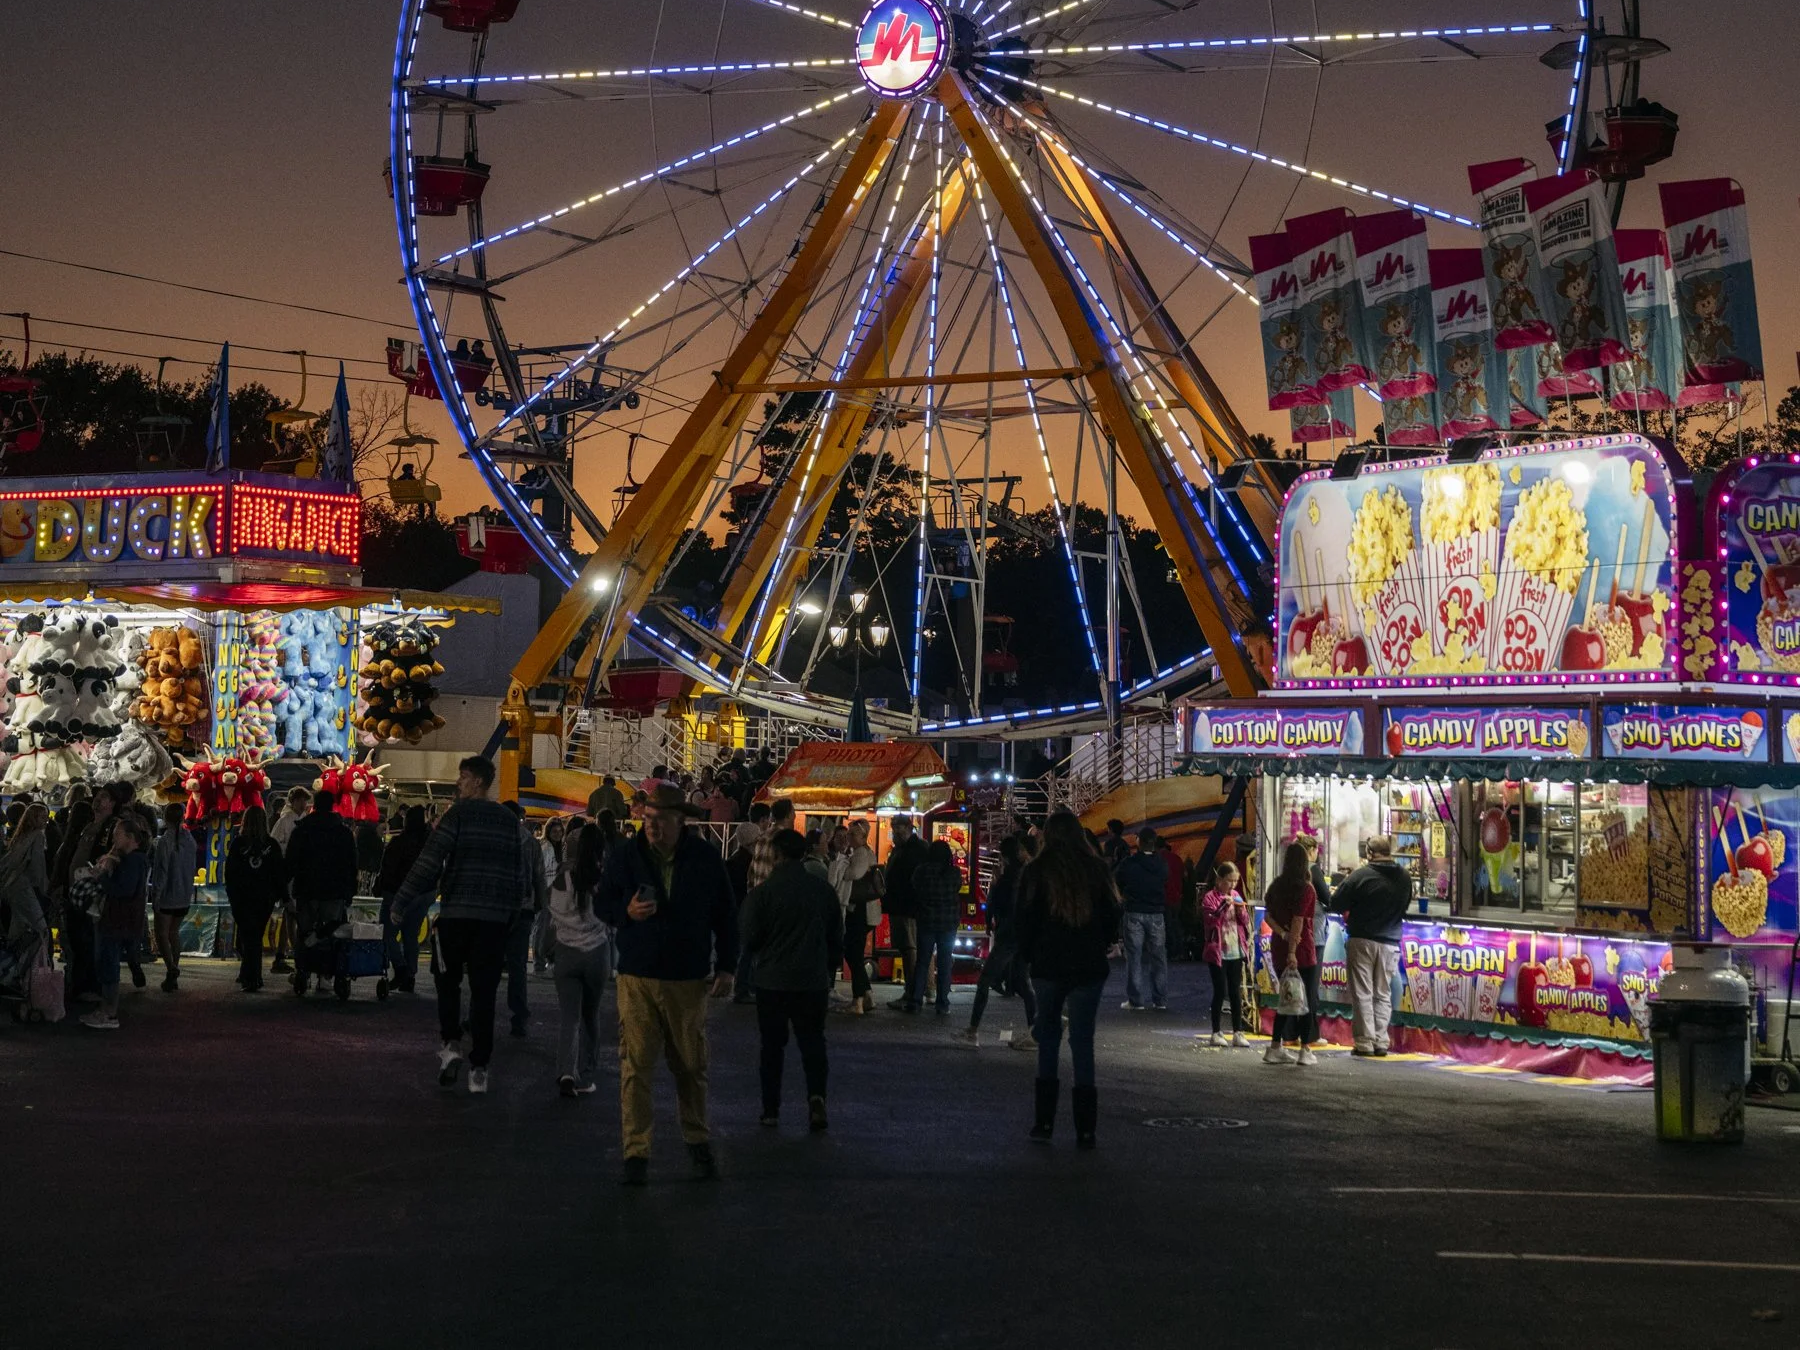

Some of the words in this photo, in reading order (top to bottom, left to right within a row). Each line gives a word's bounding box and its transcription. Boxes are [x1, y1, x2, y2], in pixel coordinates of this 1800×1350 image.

[1543, 207, 1585, 235] AMAZING
[34, 494, 216, 563] DUCK
[240, 495, 287, 551] RING
[1748, 501, 1800, 532] CAN
[1446, 544, 1473, 569] fresh
[1378, 581, 1400, 615] fresh
[1520, 579, 1547, 606] fresh
[1381, 614, 1408, 662] POP
[1504, 614, 1538, 651] POP
[1211, 719, 1278, 745] COTTON
[1283, 719, 1344, 745] CANDY
[1404, 718, 1476, 747] CANDY
[1484, 717, 1568, 748] APPLES
[1622, 719, 1741, 748] SNO-KONES
[821, 748, 887, 762] PHOTO
[1403, 940, 1506, 974] POPCORN
[1321, 966, 1349, 984] COTTO
[1536, 989, 1569, 1006] CANDY
[1571, 995, 1608, 1012] APPLES
